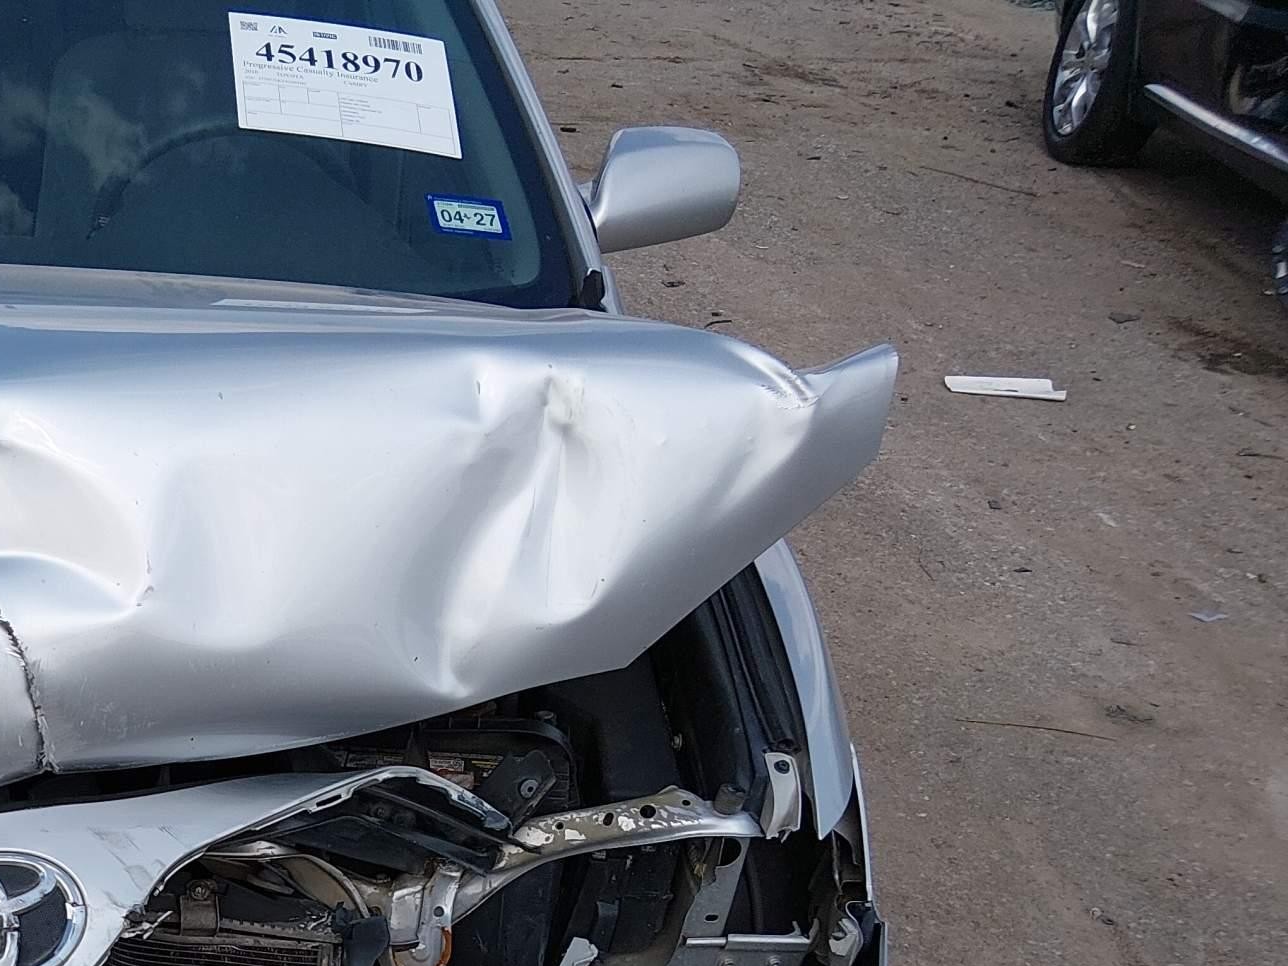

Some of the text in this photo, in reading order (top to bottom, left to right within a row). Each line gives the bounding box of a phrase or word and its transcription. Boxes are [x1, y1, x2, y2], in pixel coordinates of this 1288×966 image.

[243, 60, 379, 83] Progressive Casualty Insurance
[256, 42, 423, 82] 45418970
[440, 209, 496, 226] 04 27
